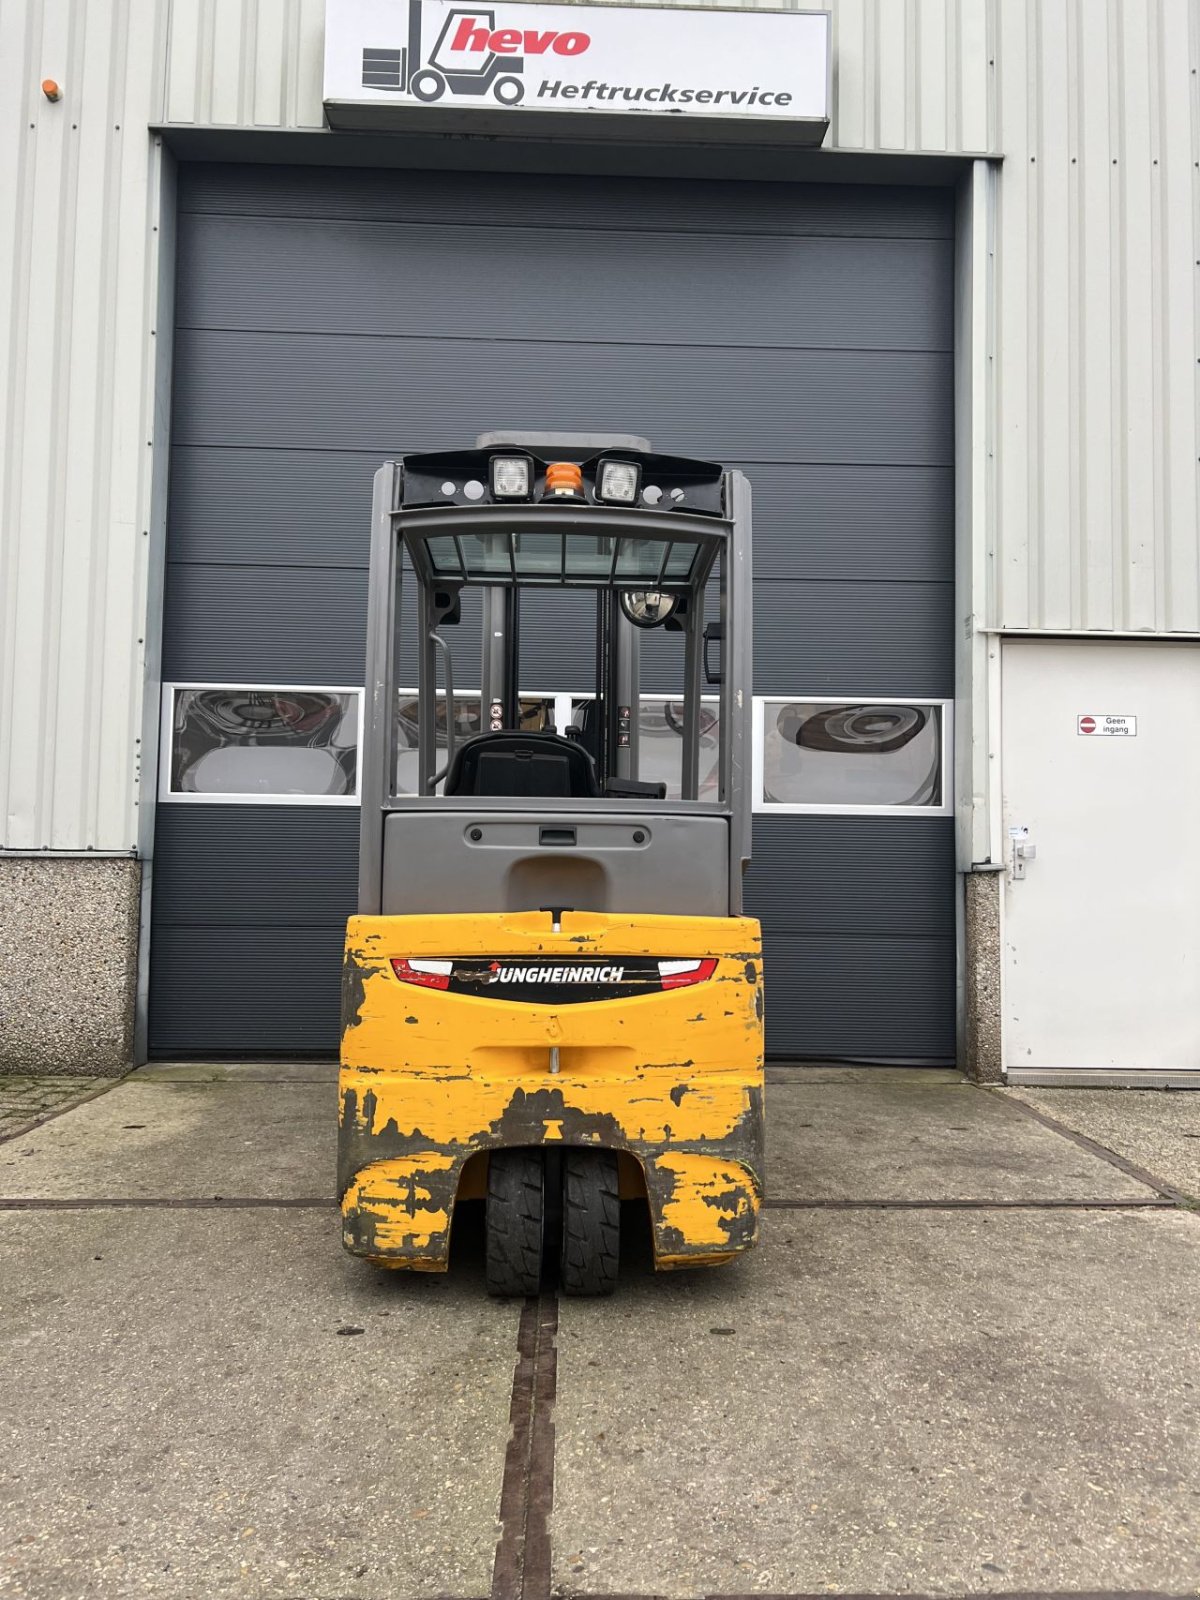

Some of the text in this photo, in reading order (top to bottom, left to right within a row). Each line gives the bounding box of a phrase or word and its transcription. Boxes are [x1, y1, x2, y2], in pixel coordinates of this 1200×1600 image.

[450, 17, 591, 56] hevo
[536, 80, 793, 106] Heftruckservice
[1103, 726, 1129, 734] ingang
[489, 966, 625, 983] JUNGHEINRICH
